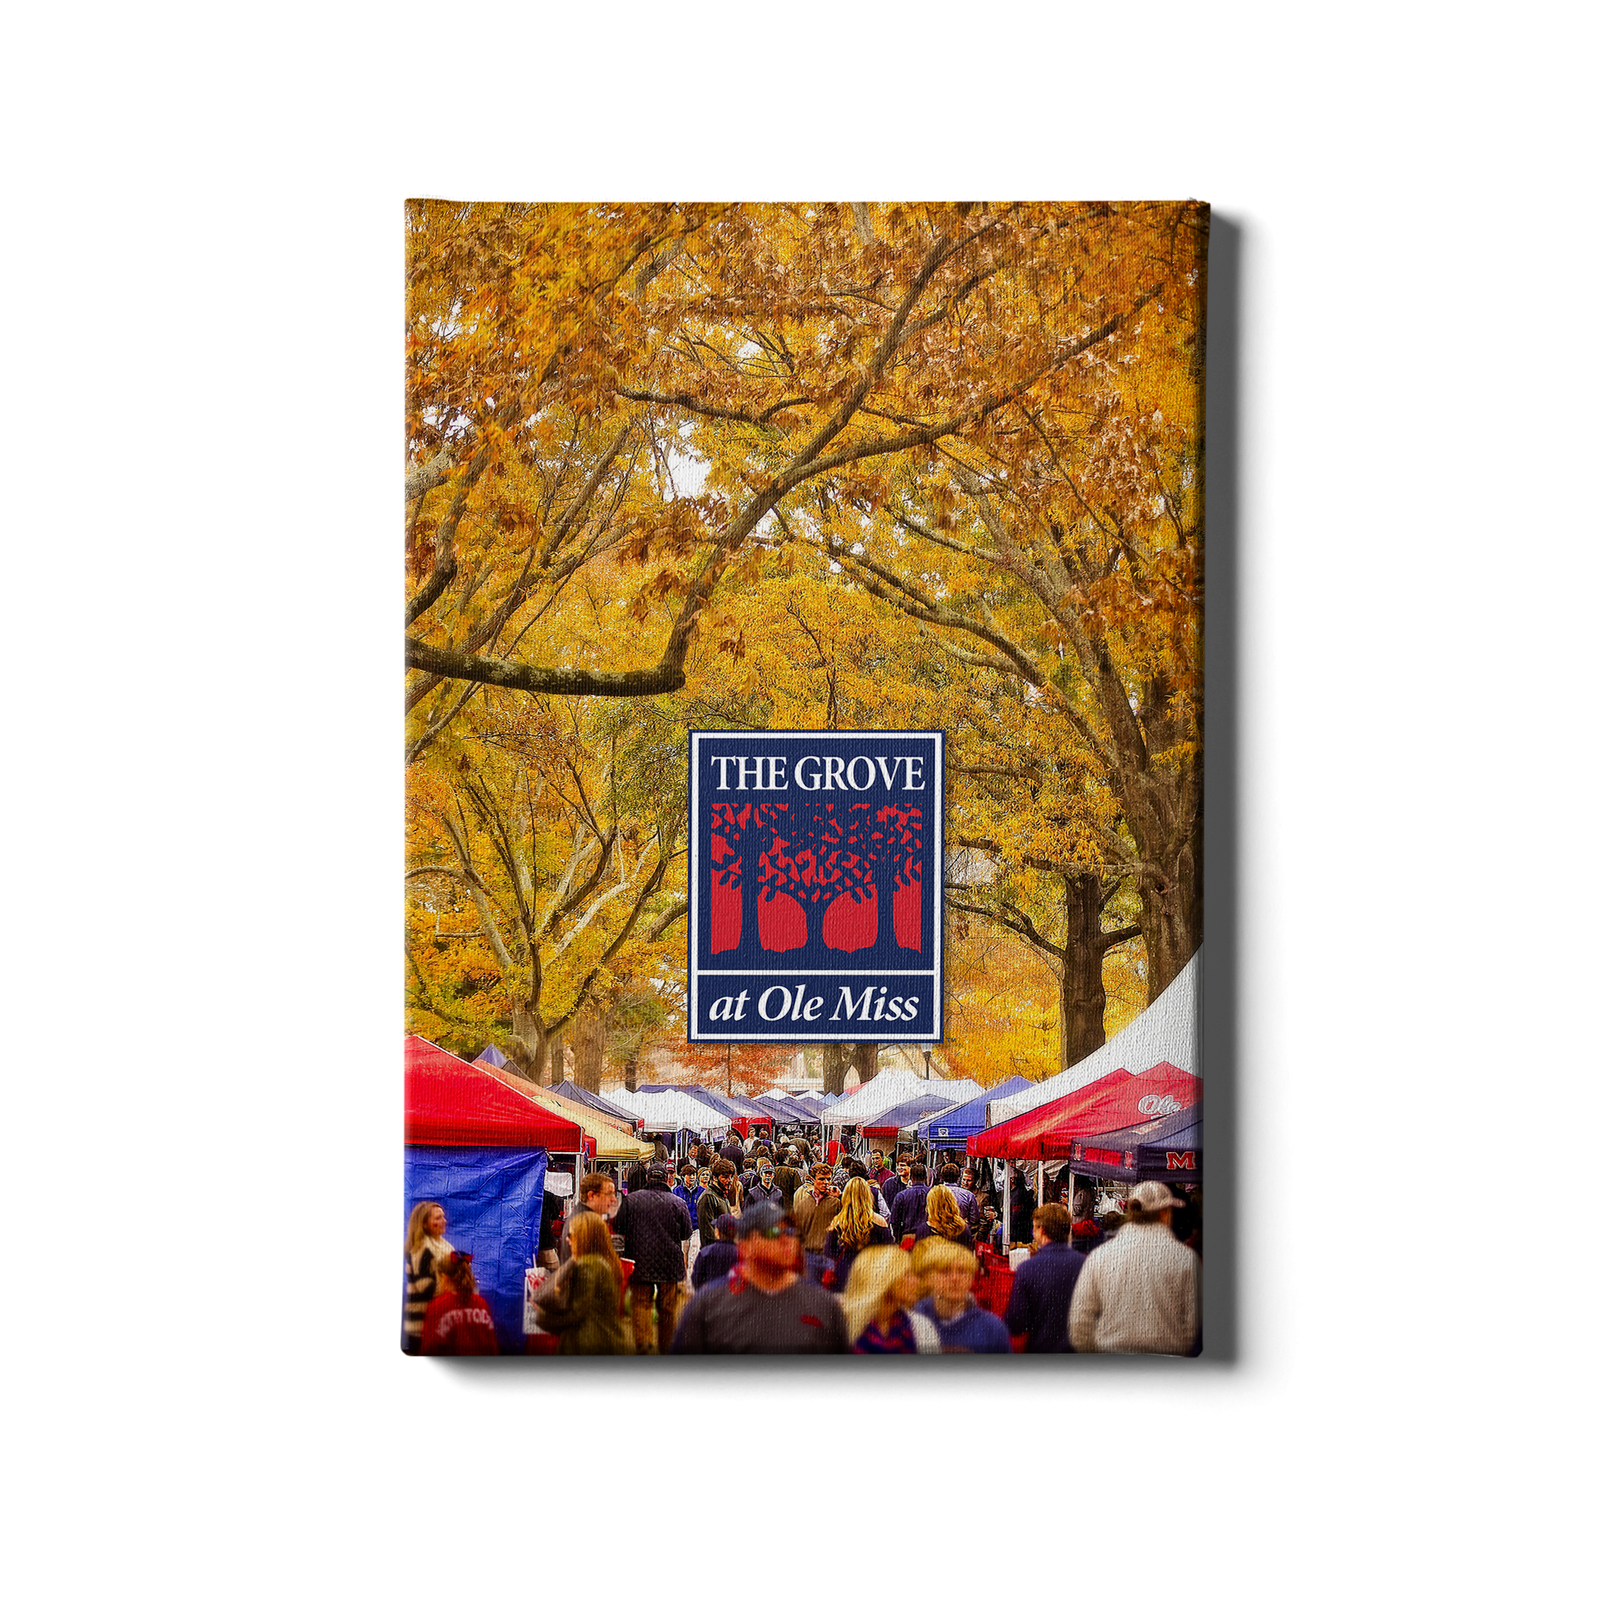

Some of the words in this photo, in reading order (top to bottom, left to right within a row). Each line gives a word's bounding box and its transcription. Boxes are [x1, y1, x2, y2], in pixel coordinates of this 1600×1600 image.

[710, 755, 789, 791] THE
[793, 755, 926, 791] GROVE
[708, 988, 751, 1022] at
[757, 984, 824, 1022] Ole
[829, 986, 920, 1022] Miss
[1137, 1094, 1182, 1115] Ole
[1166, 1151, 1196, 1170] M
